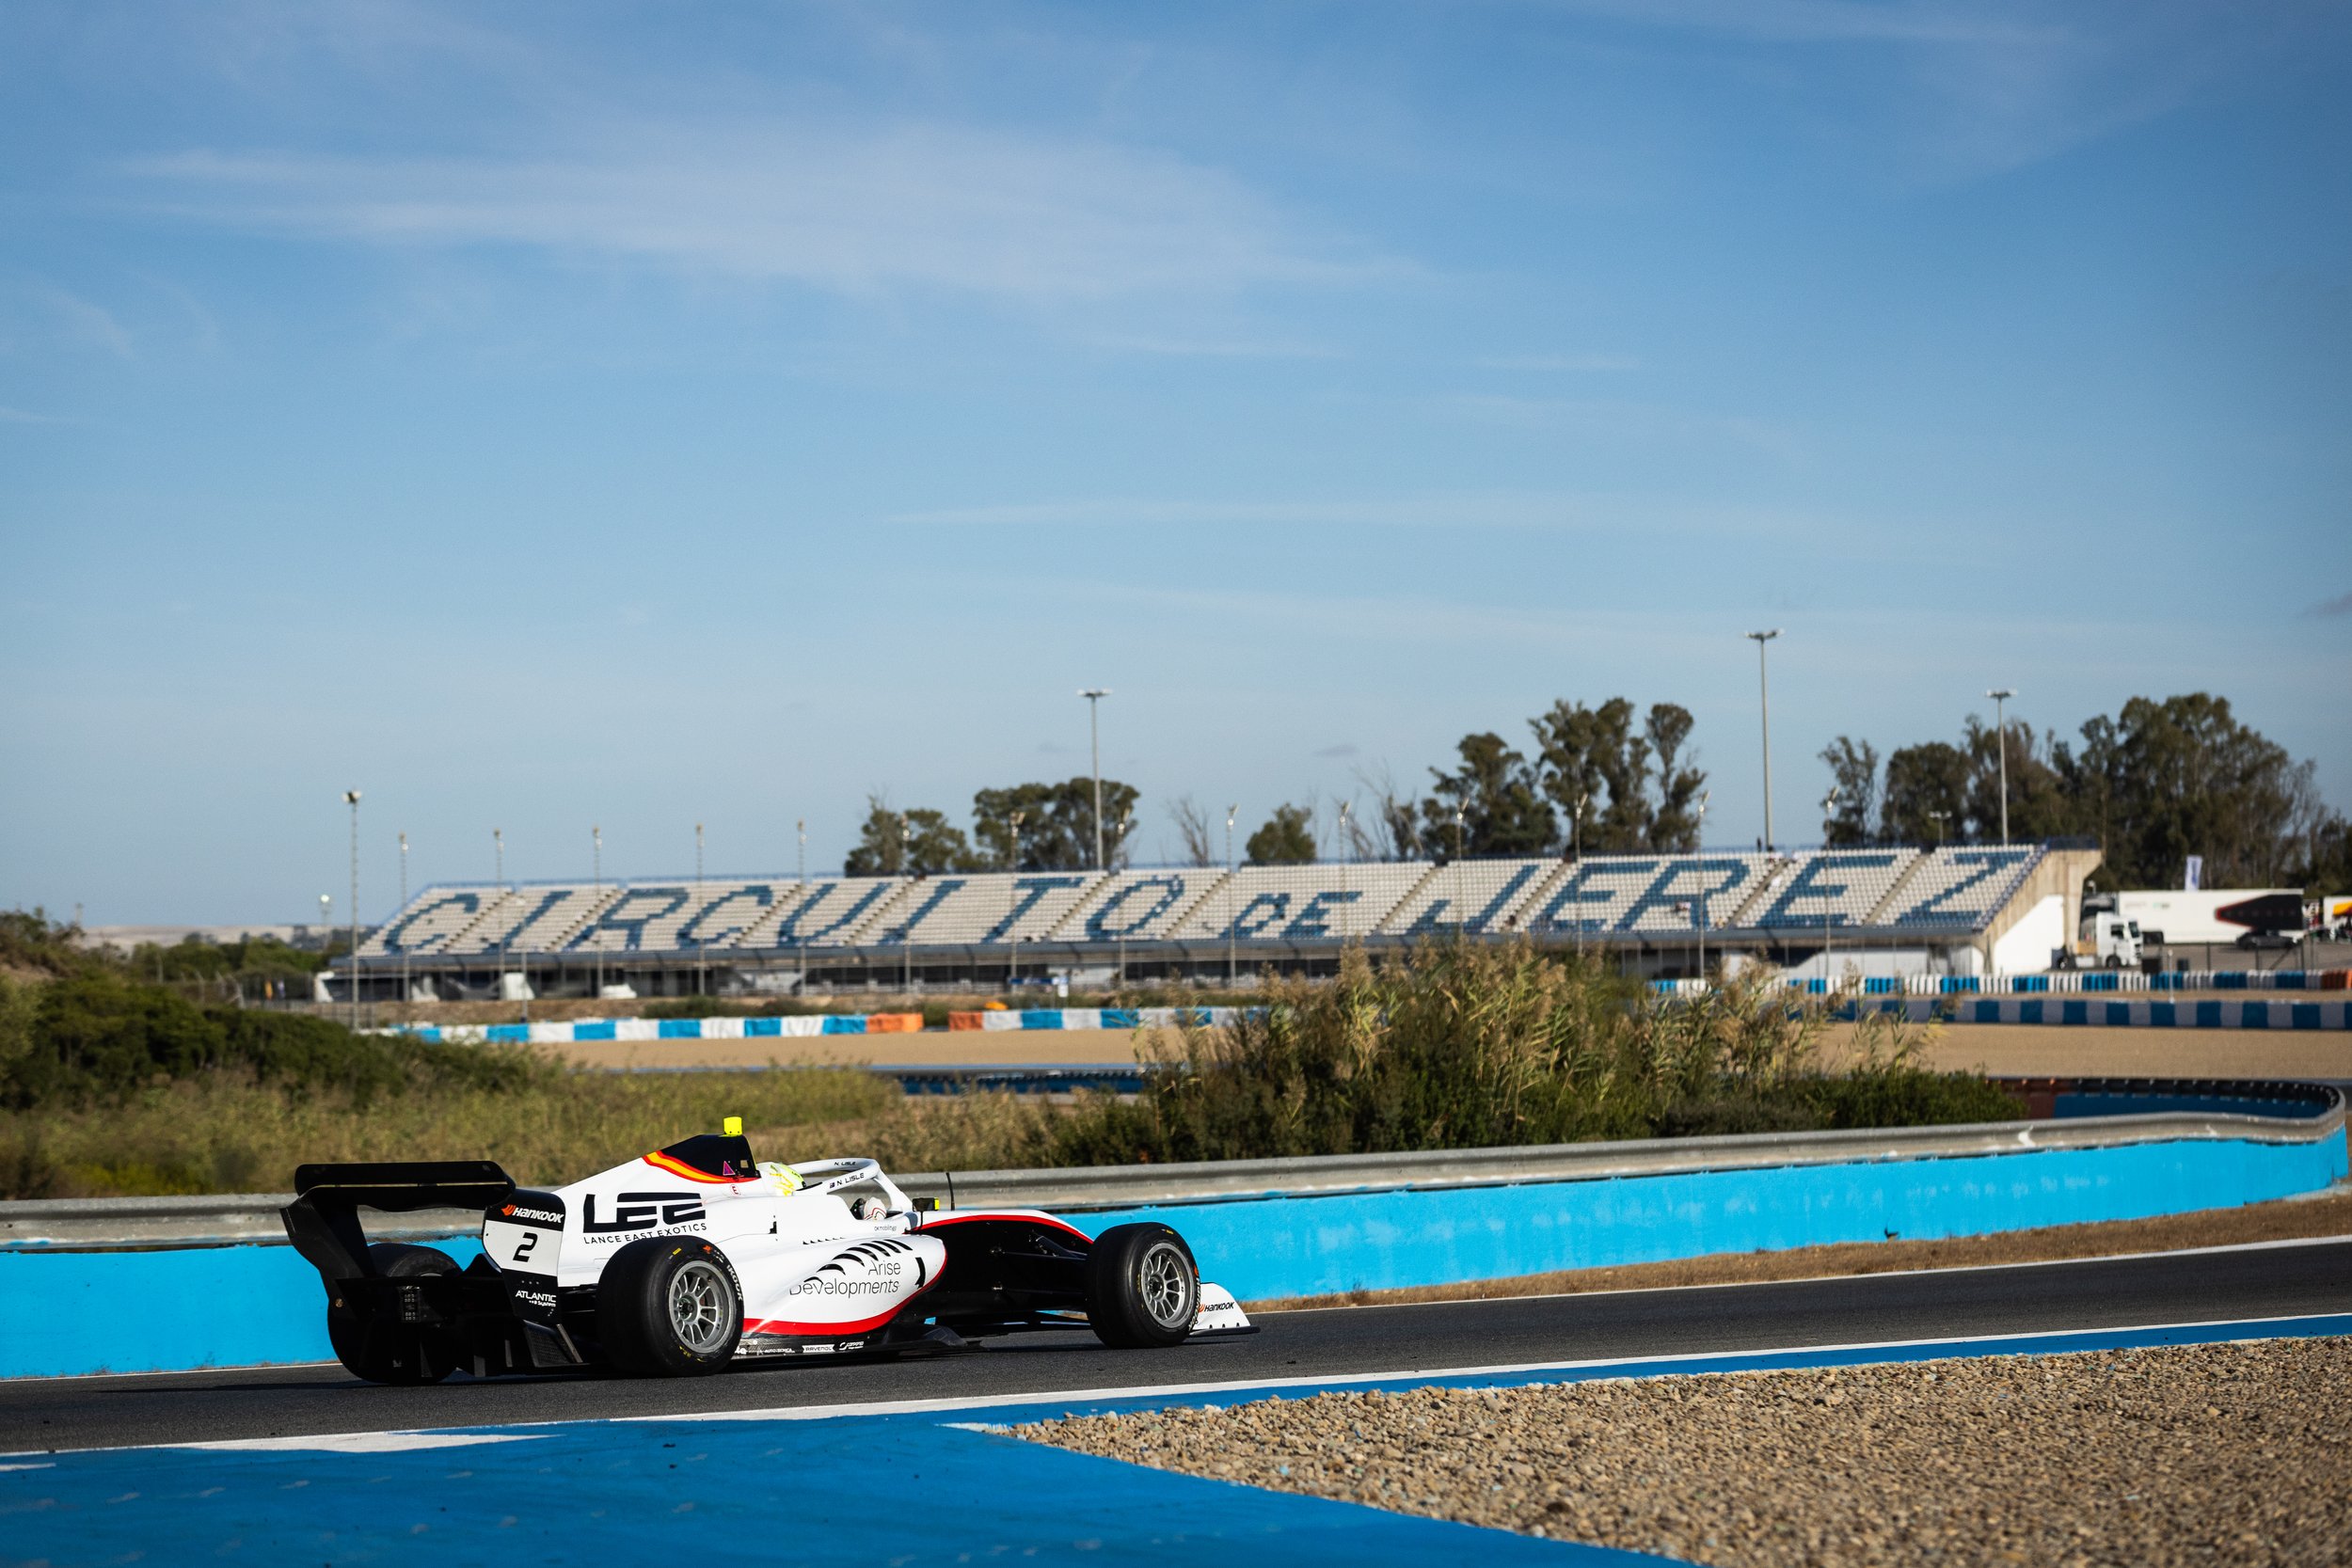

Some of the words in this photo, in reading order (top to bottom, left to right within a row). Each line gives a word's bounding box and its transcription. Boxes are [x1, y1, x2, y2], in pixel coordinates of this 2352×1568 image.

[384, 873, 1185, 955] CIRCUITO
[1217, 892, 1363, 940] DE
[1404, 849, 2029, 936] JEREZ
[845, 1172, 865, 1183] LISLE
[582, 1192, 706, 1233] LEE
[583, 1233, 622, 1244] LANCE
[627, 1231, 654, 1242] EAST
[657, 1223, 707, 1238] EXOTICS
[513, 1231, 538, 1262] 2
[867, 1260, 901, 1275] Arise
[515, 1290, 557, 1304] ATLANTIC
[789, 1278, 900, 1299] Developments
